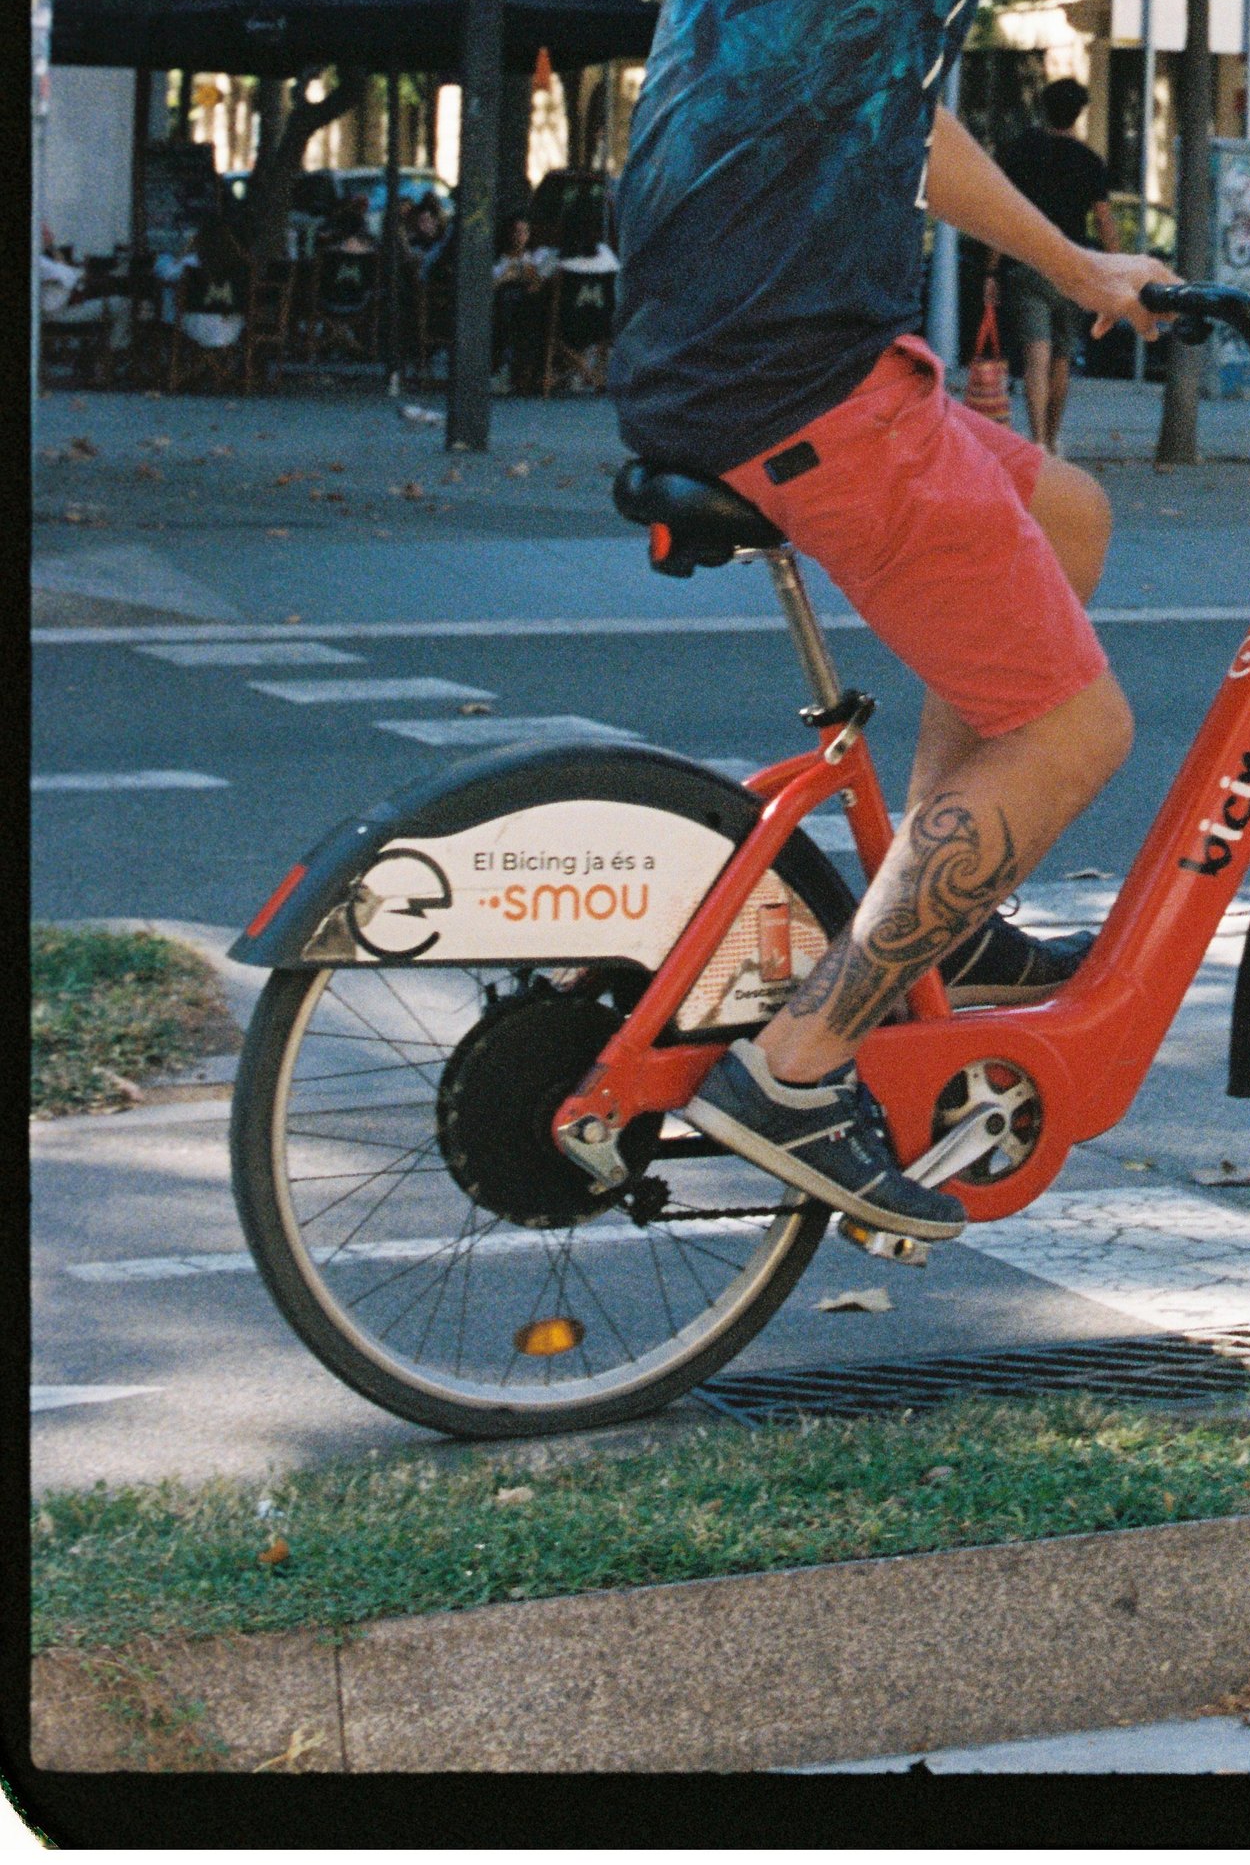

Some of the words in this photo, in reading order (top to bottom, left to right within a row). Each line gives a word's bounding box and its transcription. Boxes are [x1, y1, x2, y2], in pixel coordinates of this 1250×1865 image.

[473, 851, 495, 871] El
[502, 851, 578, 876] Bicing
[582, 851, 605, 875] ja
[610, 850, 636, 871] és
[642, 854, 656, 871] a
[502, 883, 650, 923] smou
